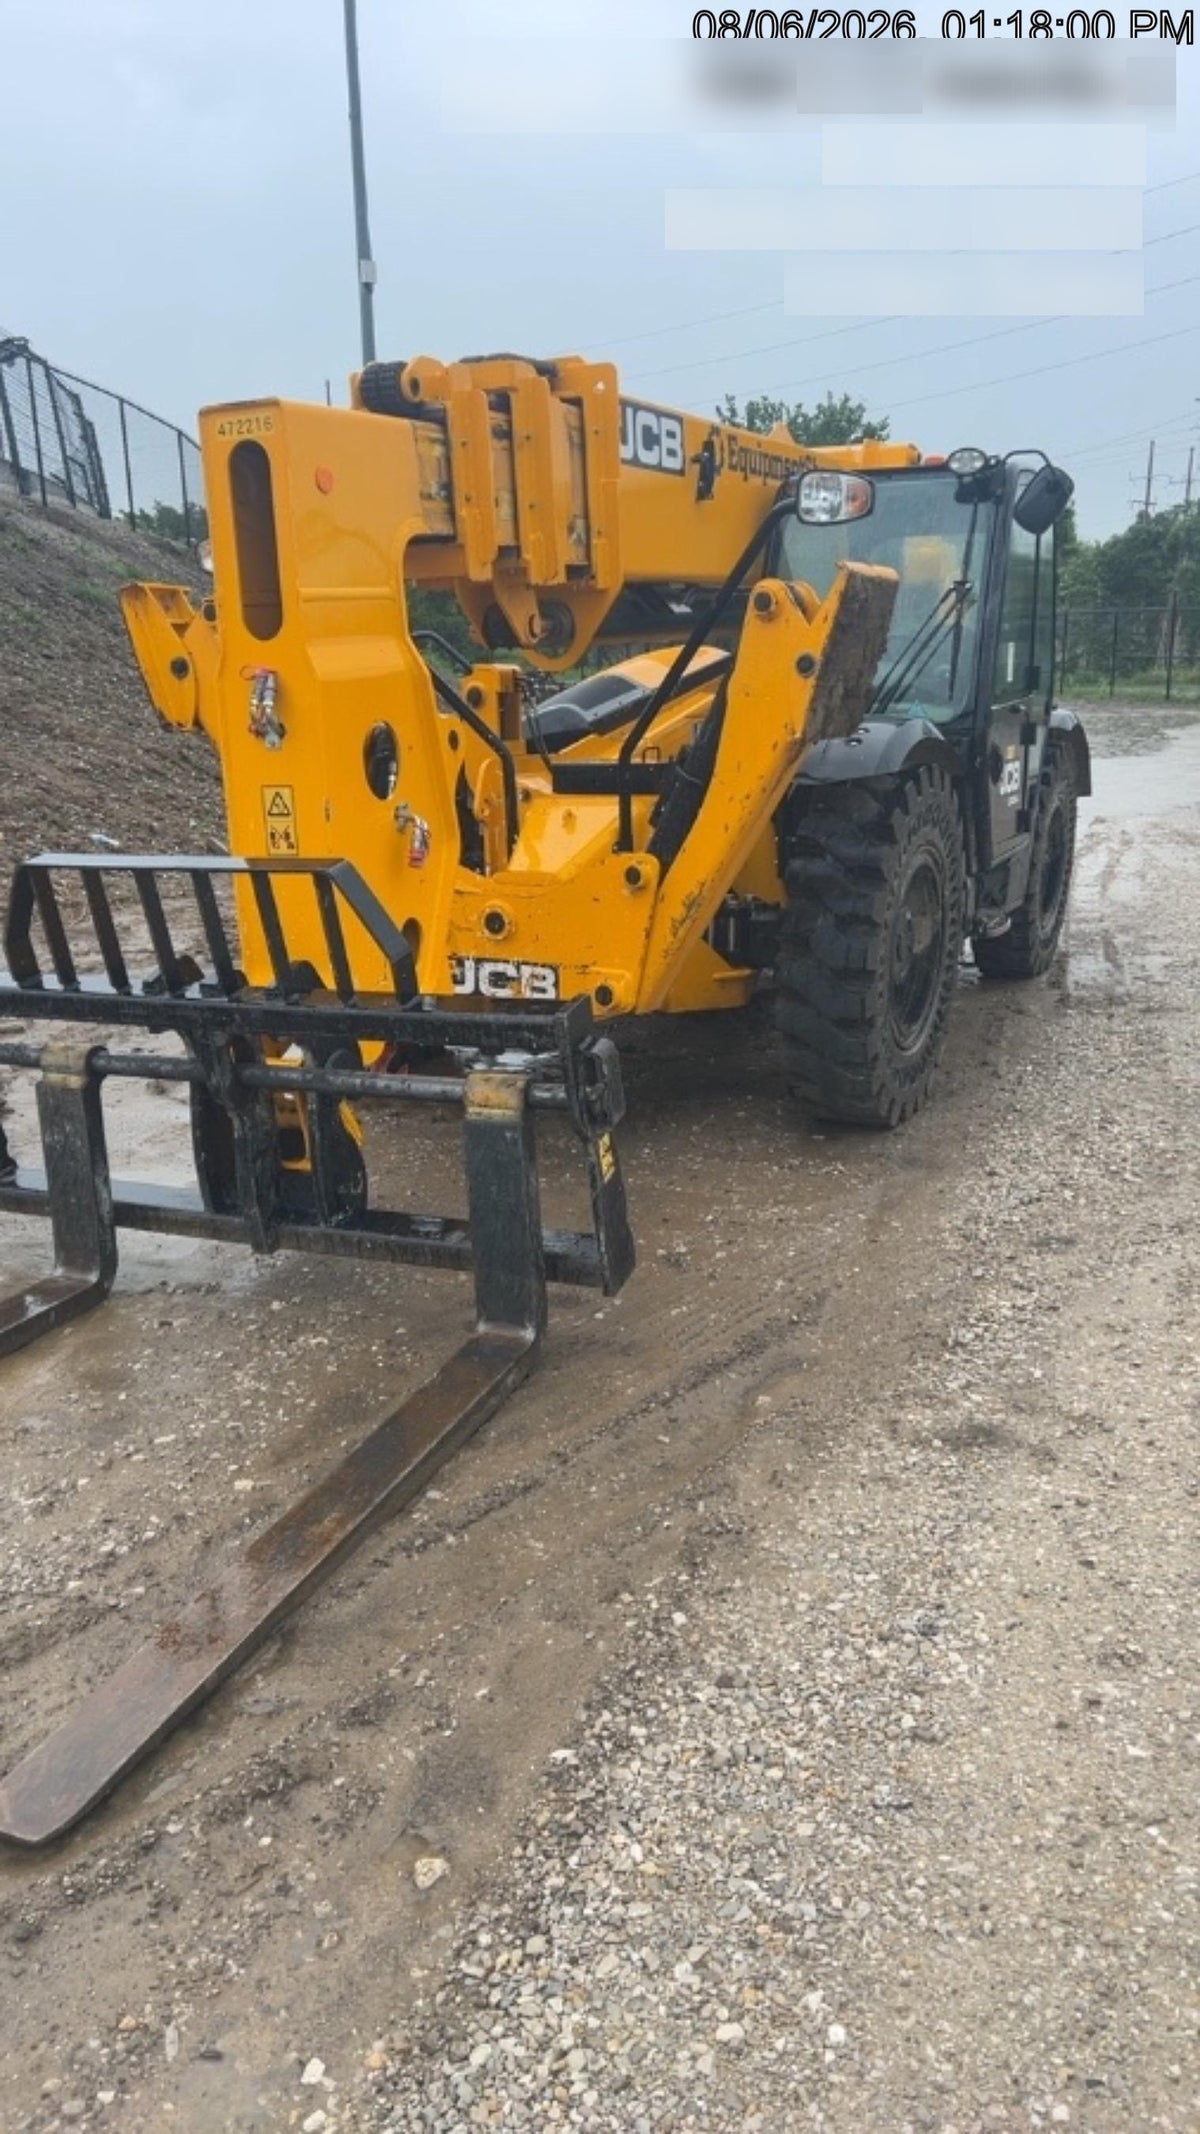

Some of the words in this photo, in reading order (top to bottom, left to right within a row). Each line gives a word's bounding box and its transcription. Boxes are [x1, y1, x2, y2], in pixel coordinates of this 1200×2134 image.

[217, 415, 272, 437] 472216
[620, 405, 683, 471] JCB
[452, 958, 556, 999] JCB
